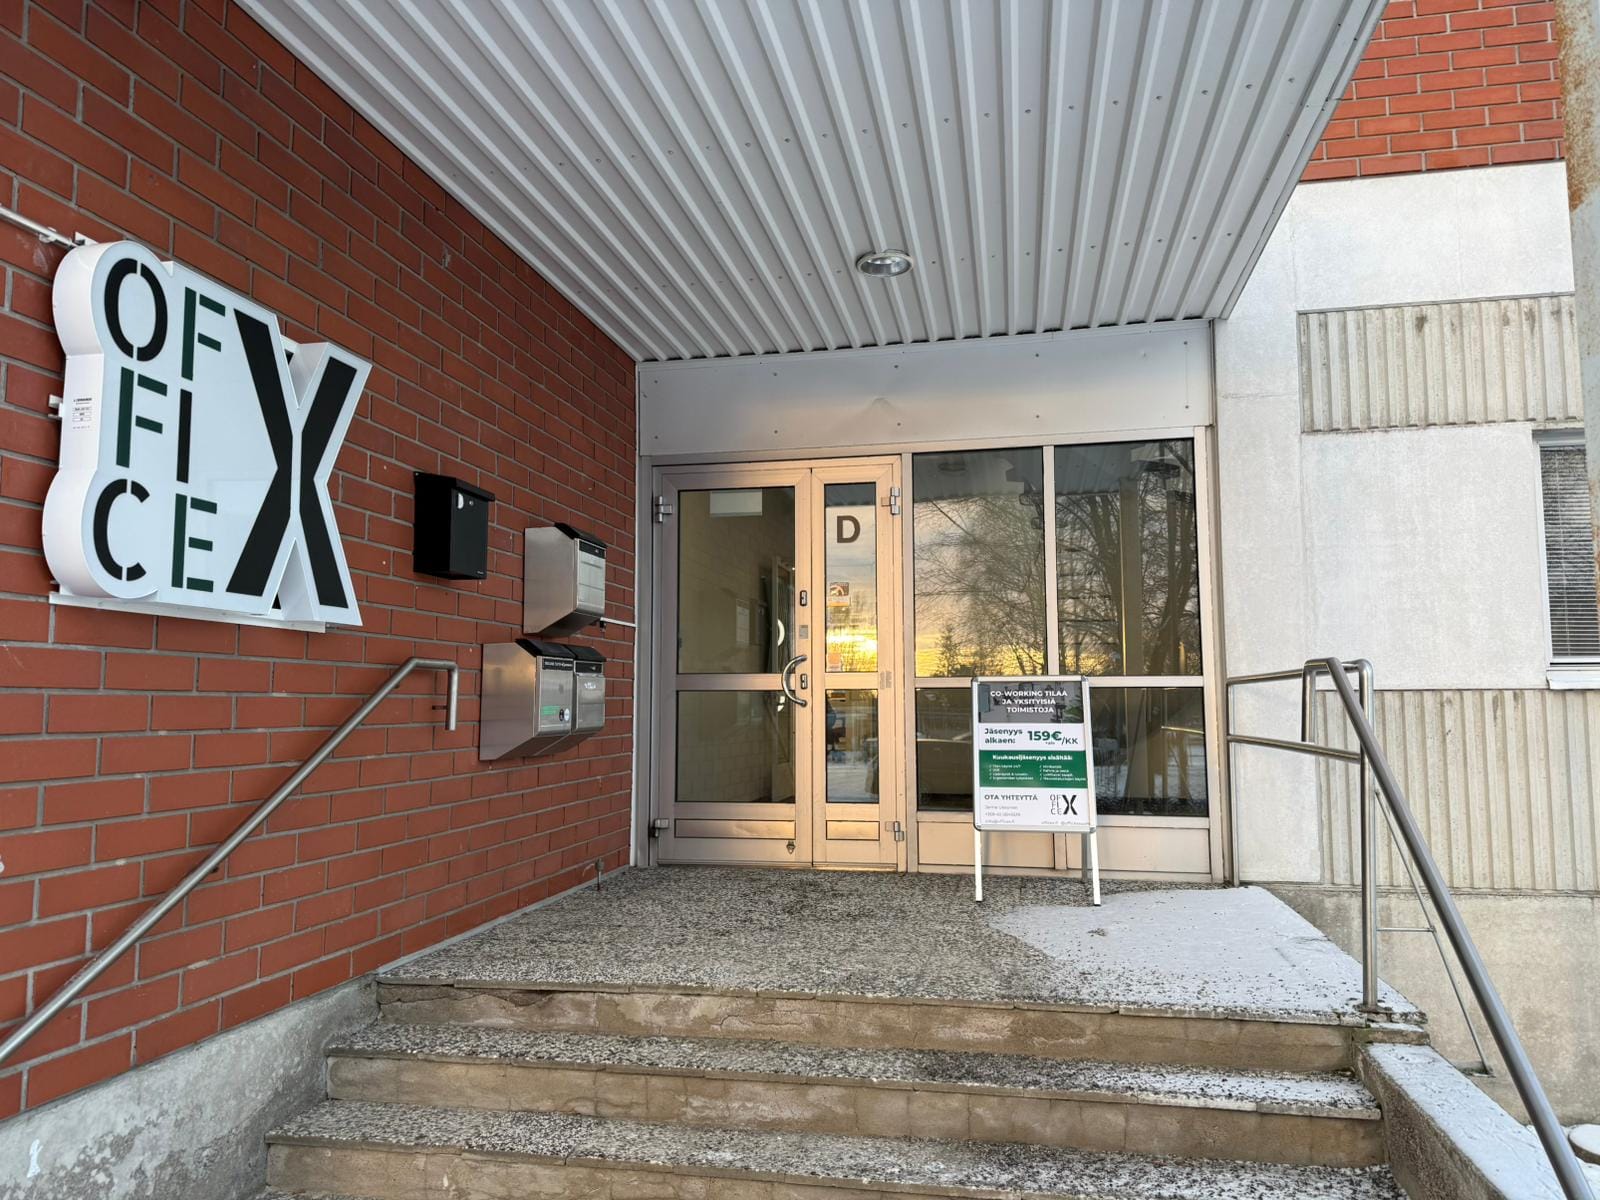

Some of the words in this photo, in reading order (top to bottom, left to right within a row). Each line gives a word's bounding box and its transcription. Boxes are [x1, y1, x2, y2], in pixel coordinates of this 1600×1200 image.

[837, 515, 860, 543] D
[1014, 697, 1056, 705] YKSITYISIÄ
[984, 727, 1023, 736] Jäsenyys
